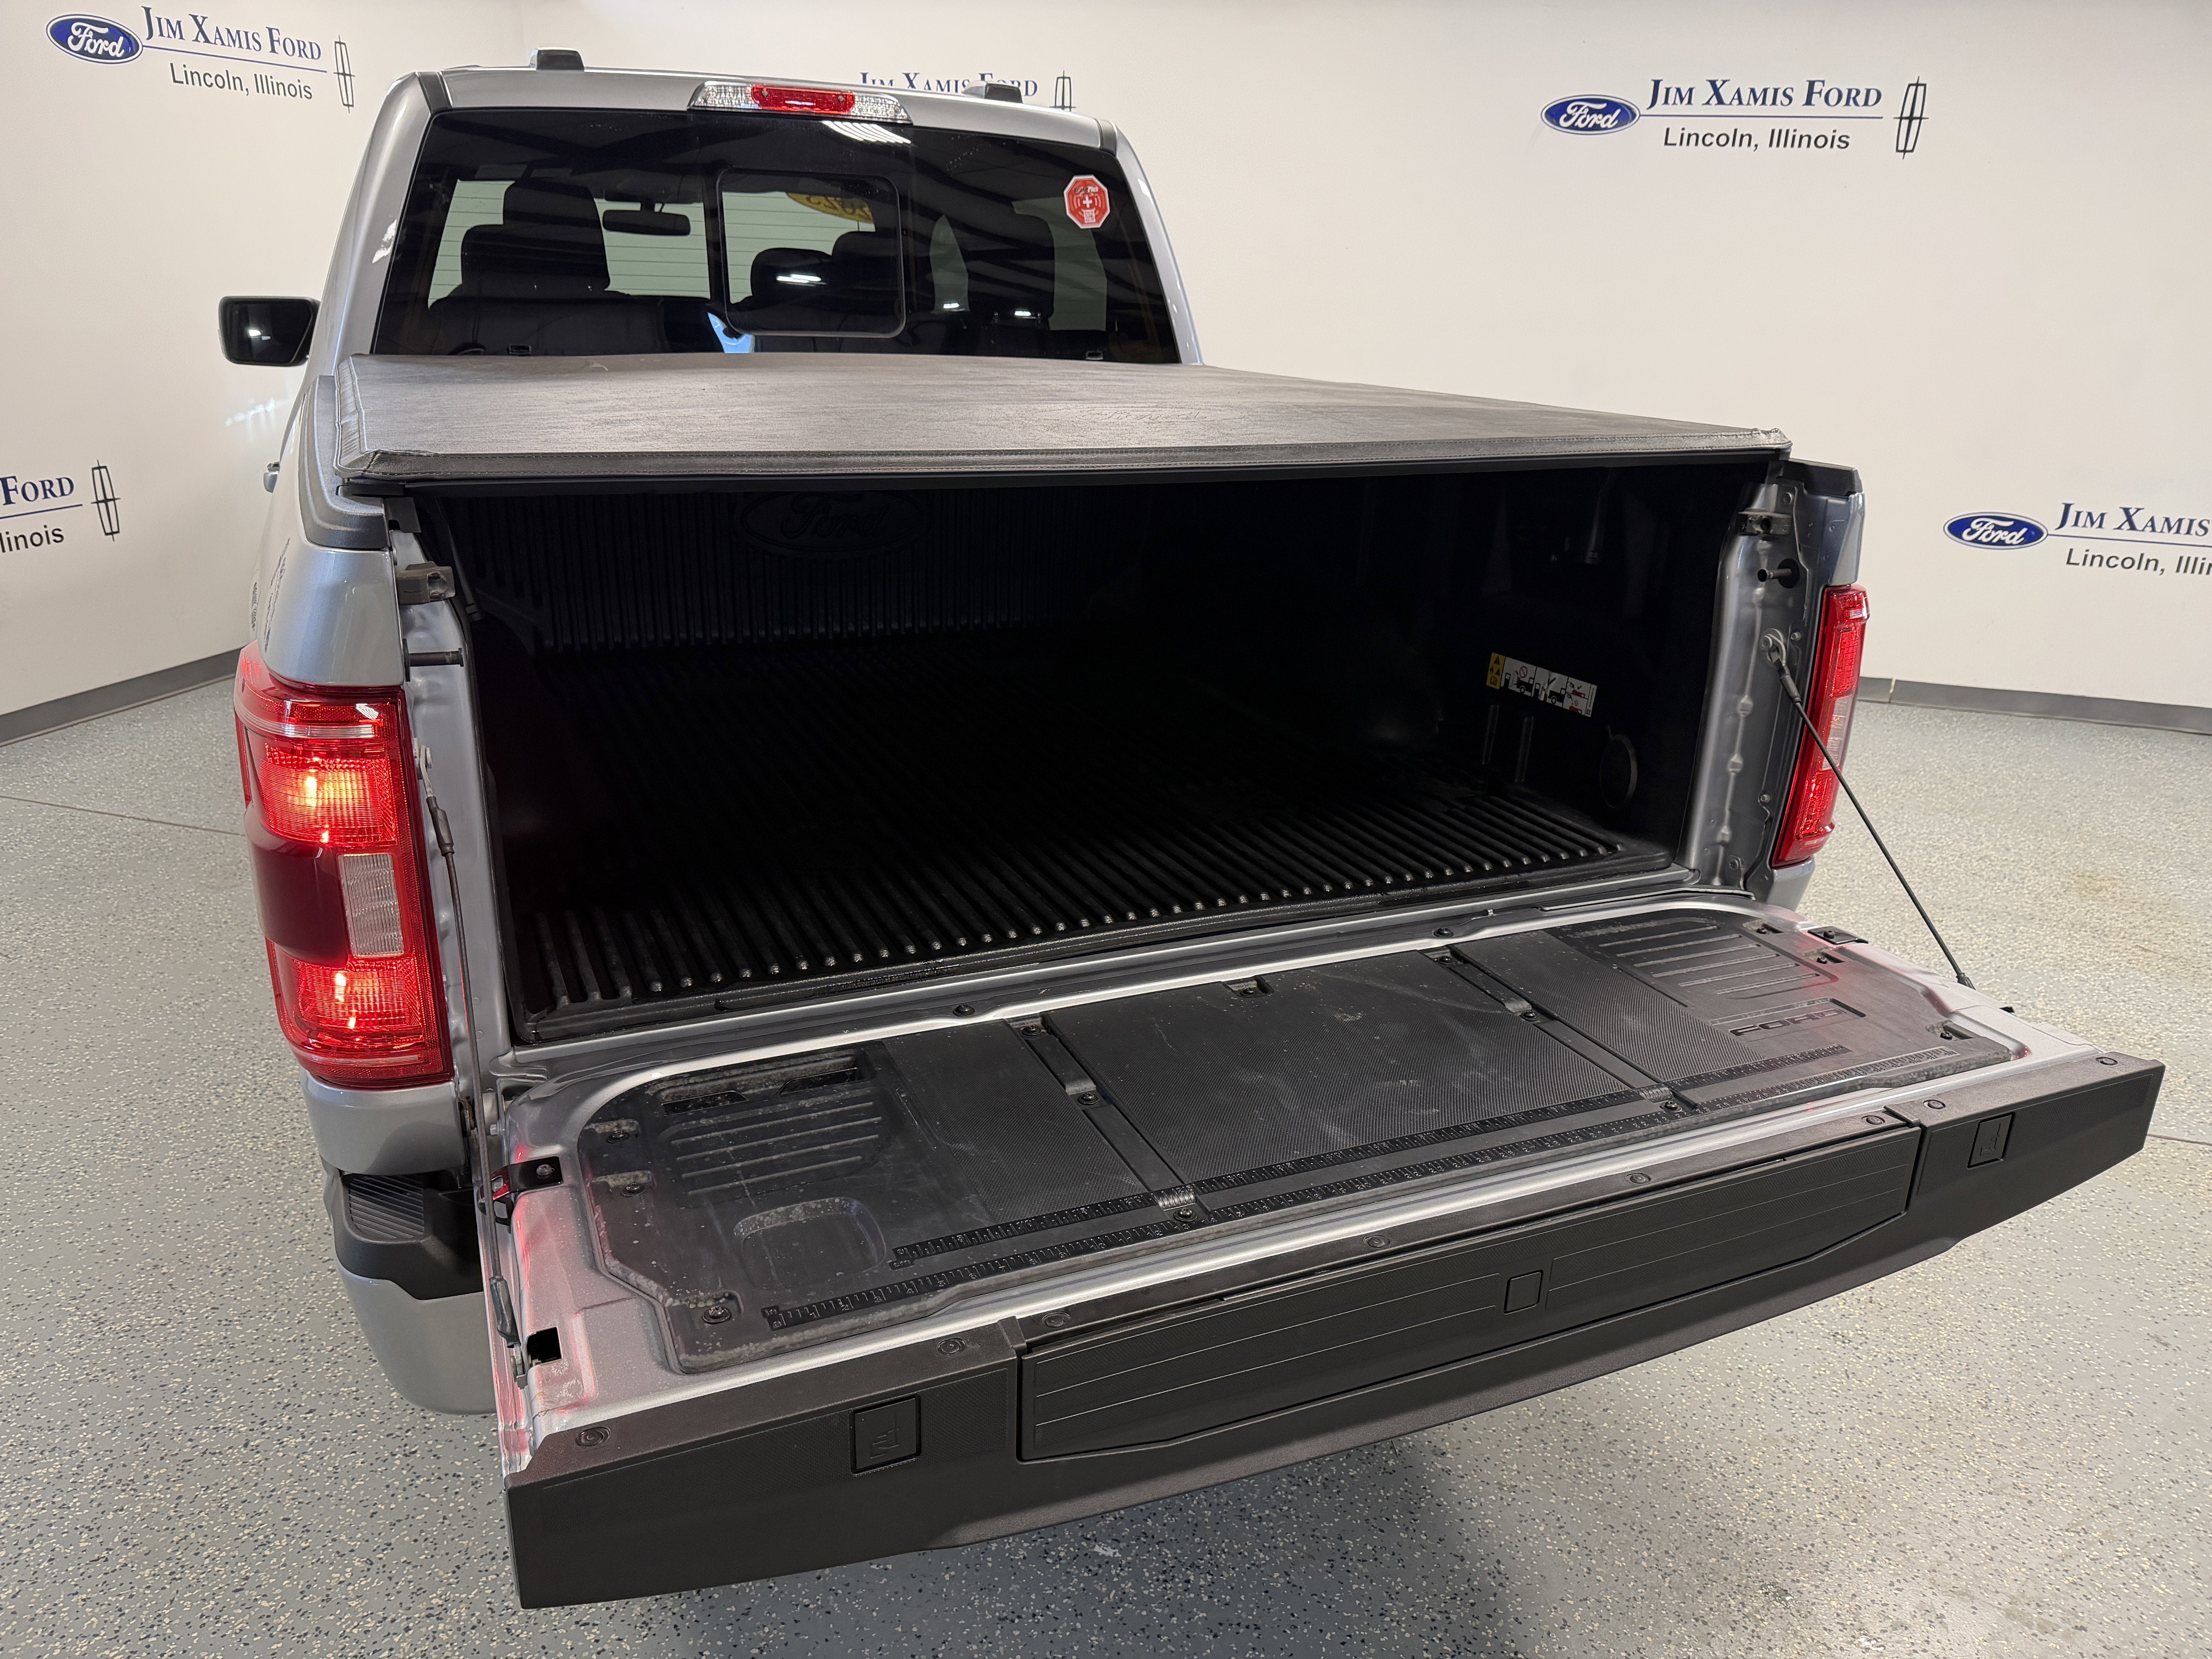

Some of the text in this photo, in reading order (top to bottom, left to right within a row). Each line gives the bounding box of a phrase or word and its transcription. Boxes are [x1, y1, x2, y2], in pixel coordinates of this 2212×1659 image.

[68, 22, 125, 57] Ford
[141, 6, 321, 60] JIM XAMIS FORD
[170, 63, 312, 99] Lincoln, Illinois
[1647, 79, 1882, 110] JIM XAMIS FORD
[1559, 101, 1620, 130] Ford
[1664, 128, 1850, 151] Lincoln, Illinois
[0, 476, 74, 506] FORD
[1962, 517, 2028, 545] Ford
[2055, 503, 2210, 536] JIM XAMIS
[2066, 548, 2165, 575] Lincoln,
